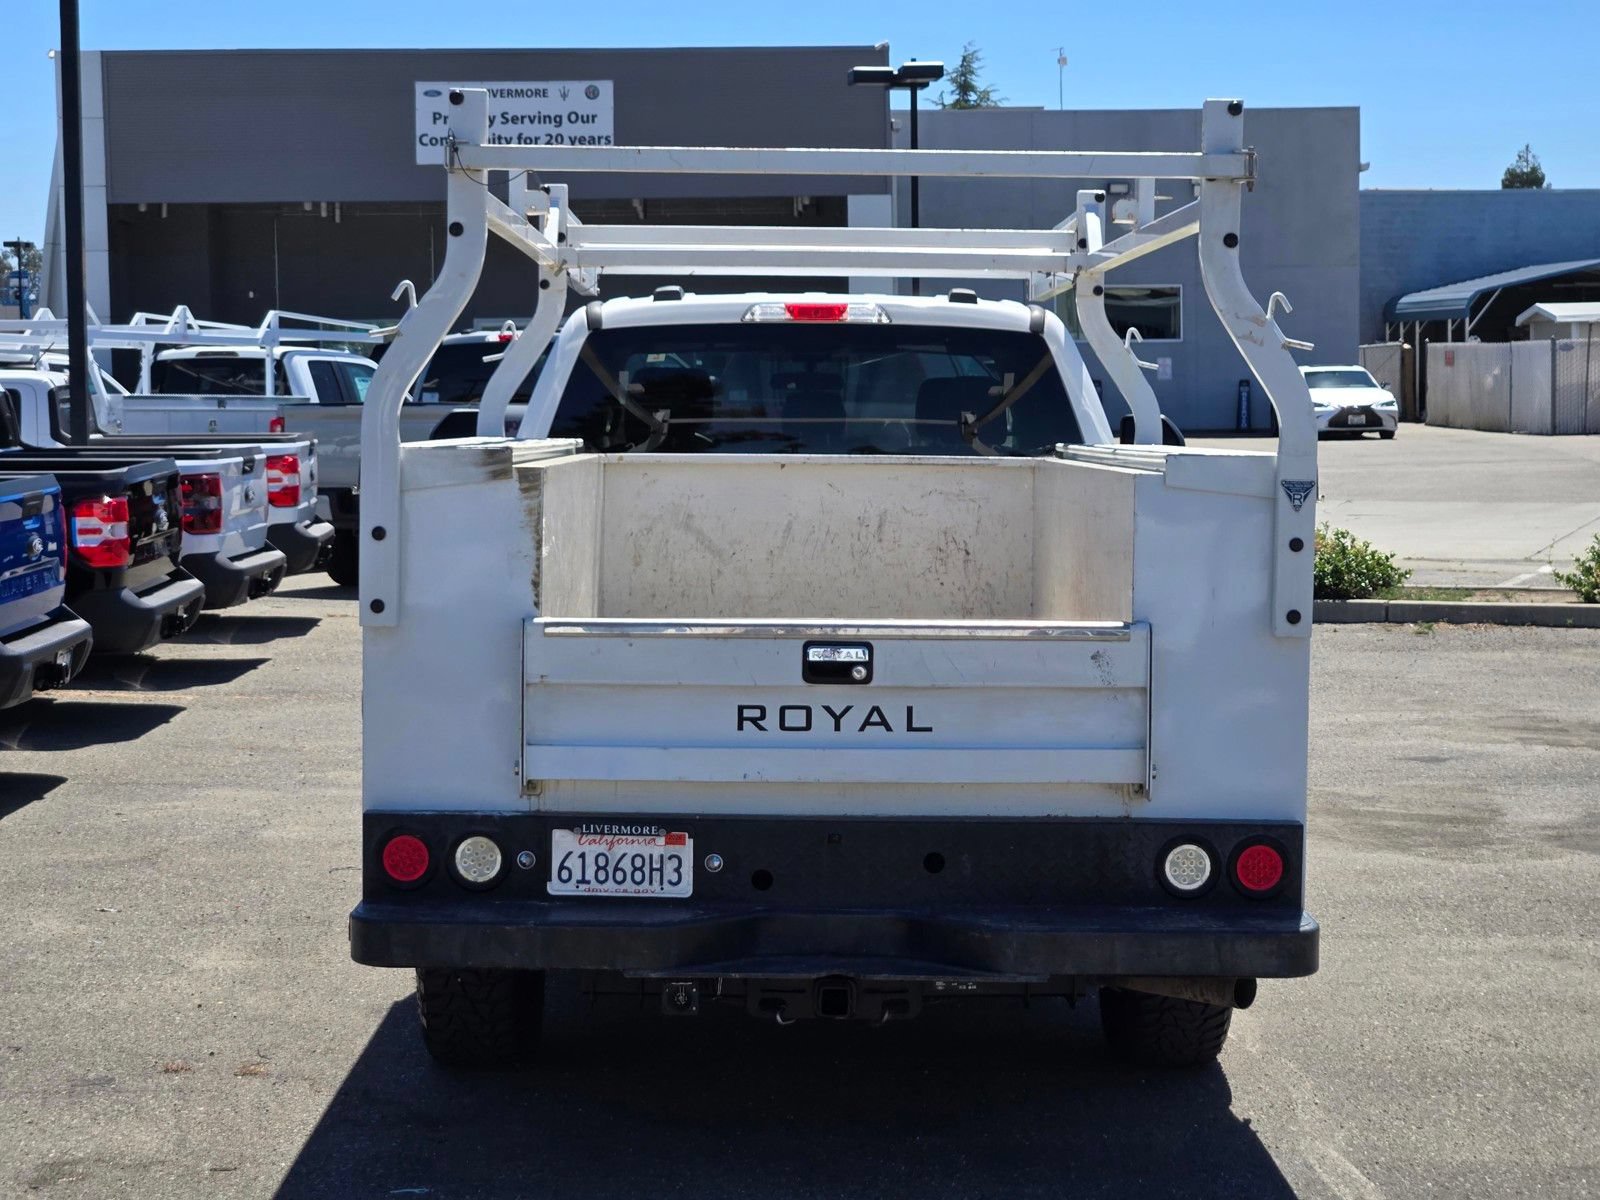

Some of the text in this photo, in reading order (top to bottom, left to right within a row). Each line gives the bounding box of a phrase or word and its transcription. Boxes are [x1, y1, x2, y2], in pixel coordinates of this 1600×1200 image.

[500, 111, 563, 128] Serving
[567, 110, 598, 125] Our
[517, 132, 541, 145] for
[544, 133, 564, 146] 20
[811, 650, 865, 660] ROYAL
[737, 704, 933, 732] ROYAL
[582, 823, 659, 835] LIVERMORE
[578, 834, 656, 850] California
[557, 851, 683, 886] 61868H3
